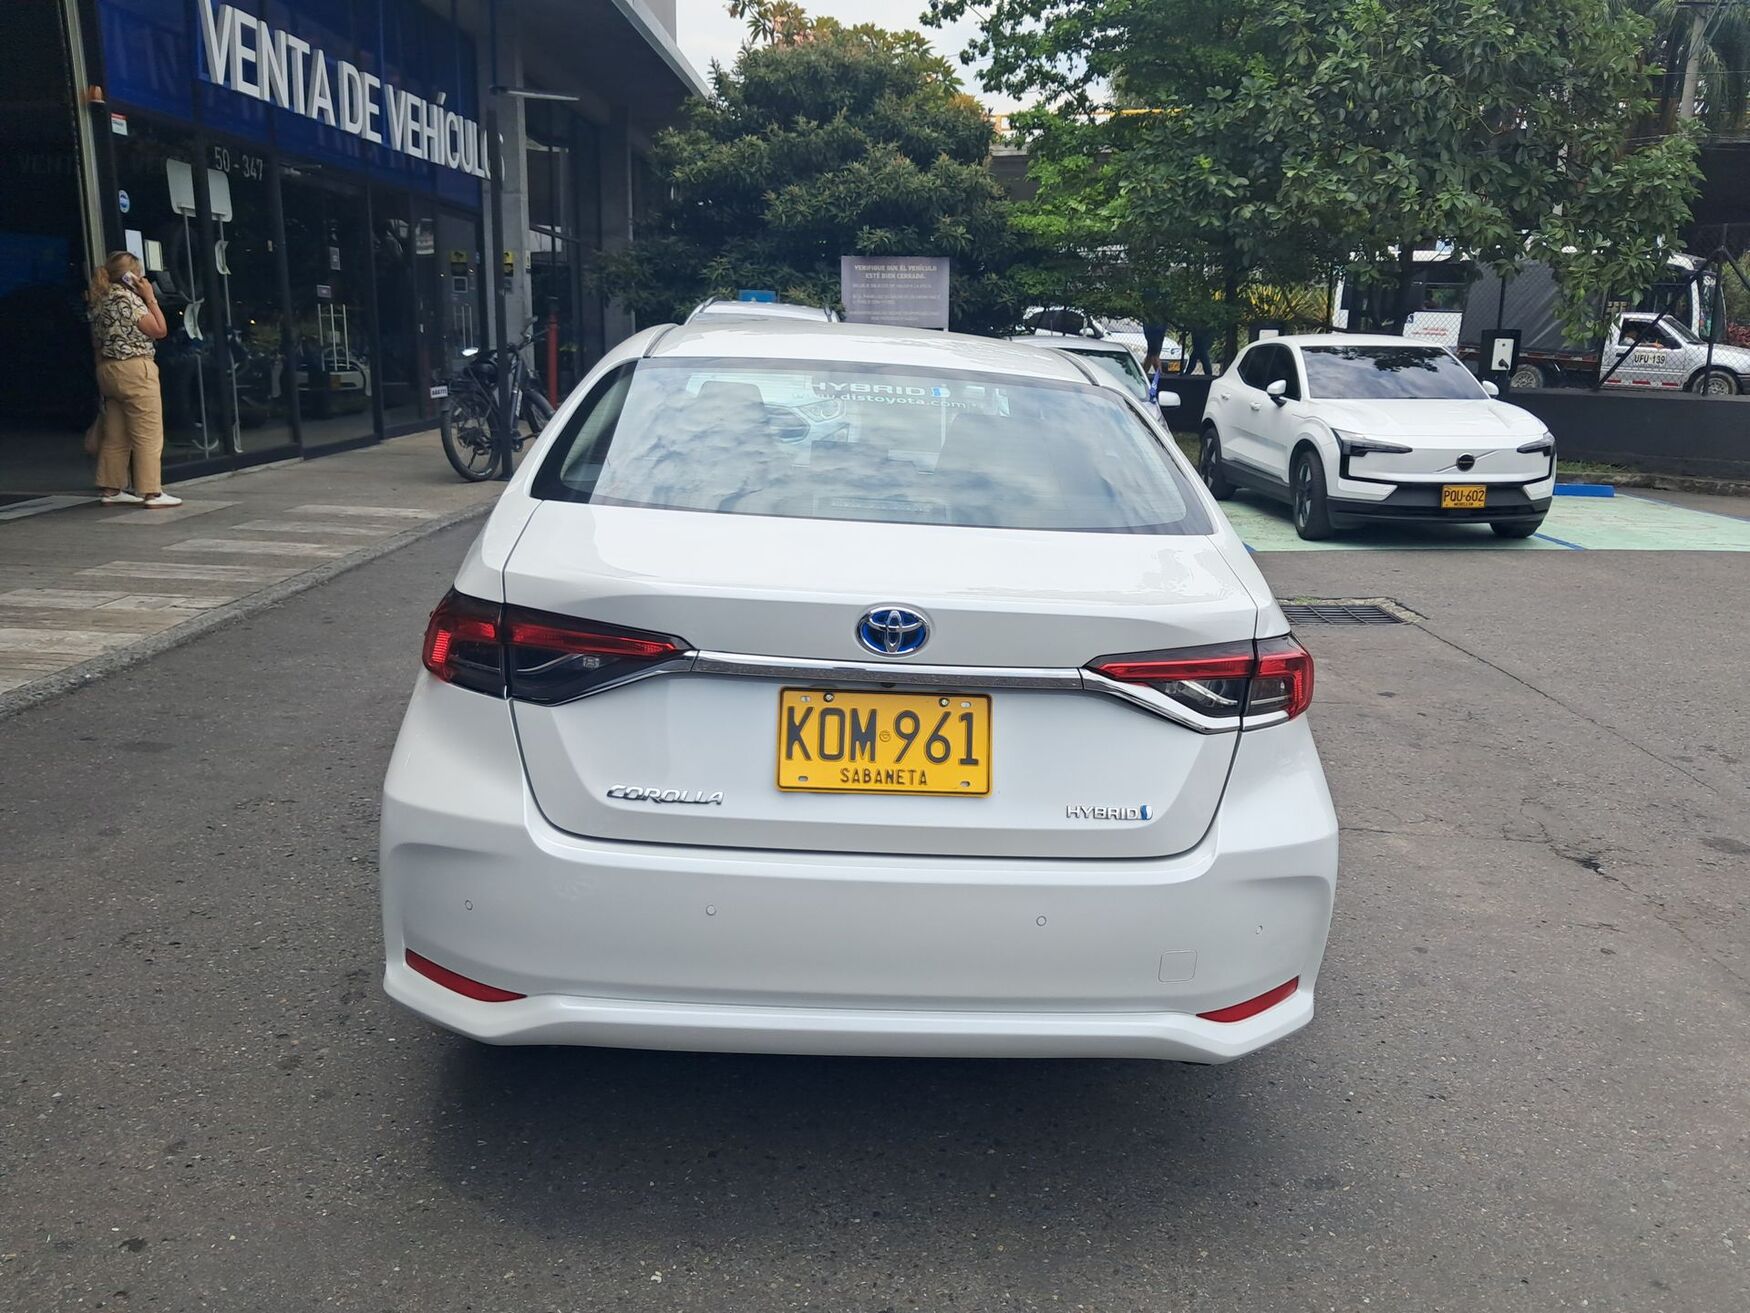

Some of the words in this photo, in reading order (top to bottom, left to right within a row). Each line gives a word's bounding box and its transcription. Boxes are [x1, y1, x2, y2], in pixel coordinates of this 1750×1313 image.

[197, 0, 336, 127] VENTA
[338, 60, 382, 144] DE
[214, 146, 231, 173] 50
[242, 154, 263, 181] 347
[805, 381, 926, 397] HYBRID
[793, 391, 967, 409] www.distoyota.com
[785, 705, 877, 764] KOM
[893, 709, 979, 767] 961
[840, 767, 928, 786] SABANETA
[607, 784, 724, 805] COROLLA
[1066, 805, 1139, 821] HYBRID
